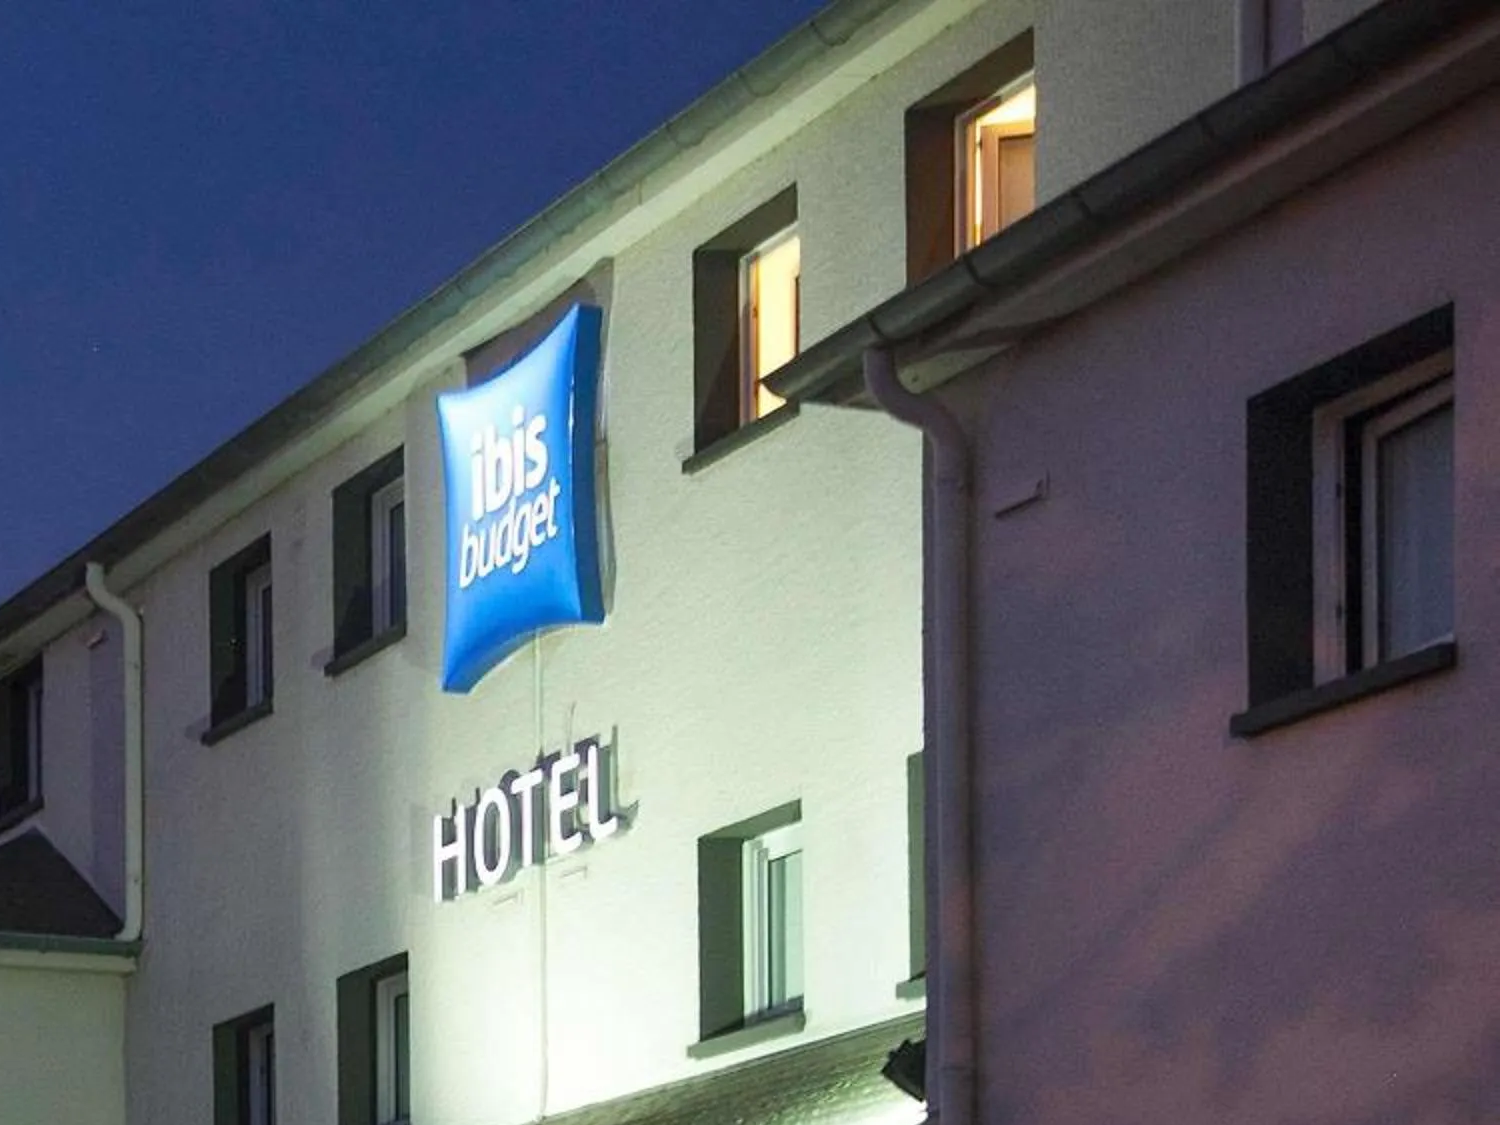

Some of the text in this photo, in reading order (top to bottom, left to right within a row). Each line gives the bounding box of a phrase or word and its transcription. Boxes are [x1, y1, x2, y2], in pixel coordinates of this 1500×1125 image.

[469, 405, 549, 521] ibis
[458, 477, 560, 589] budget
[433, 744, 618, 903] HOTEL
